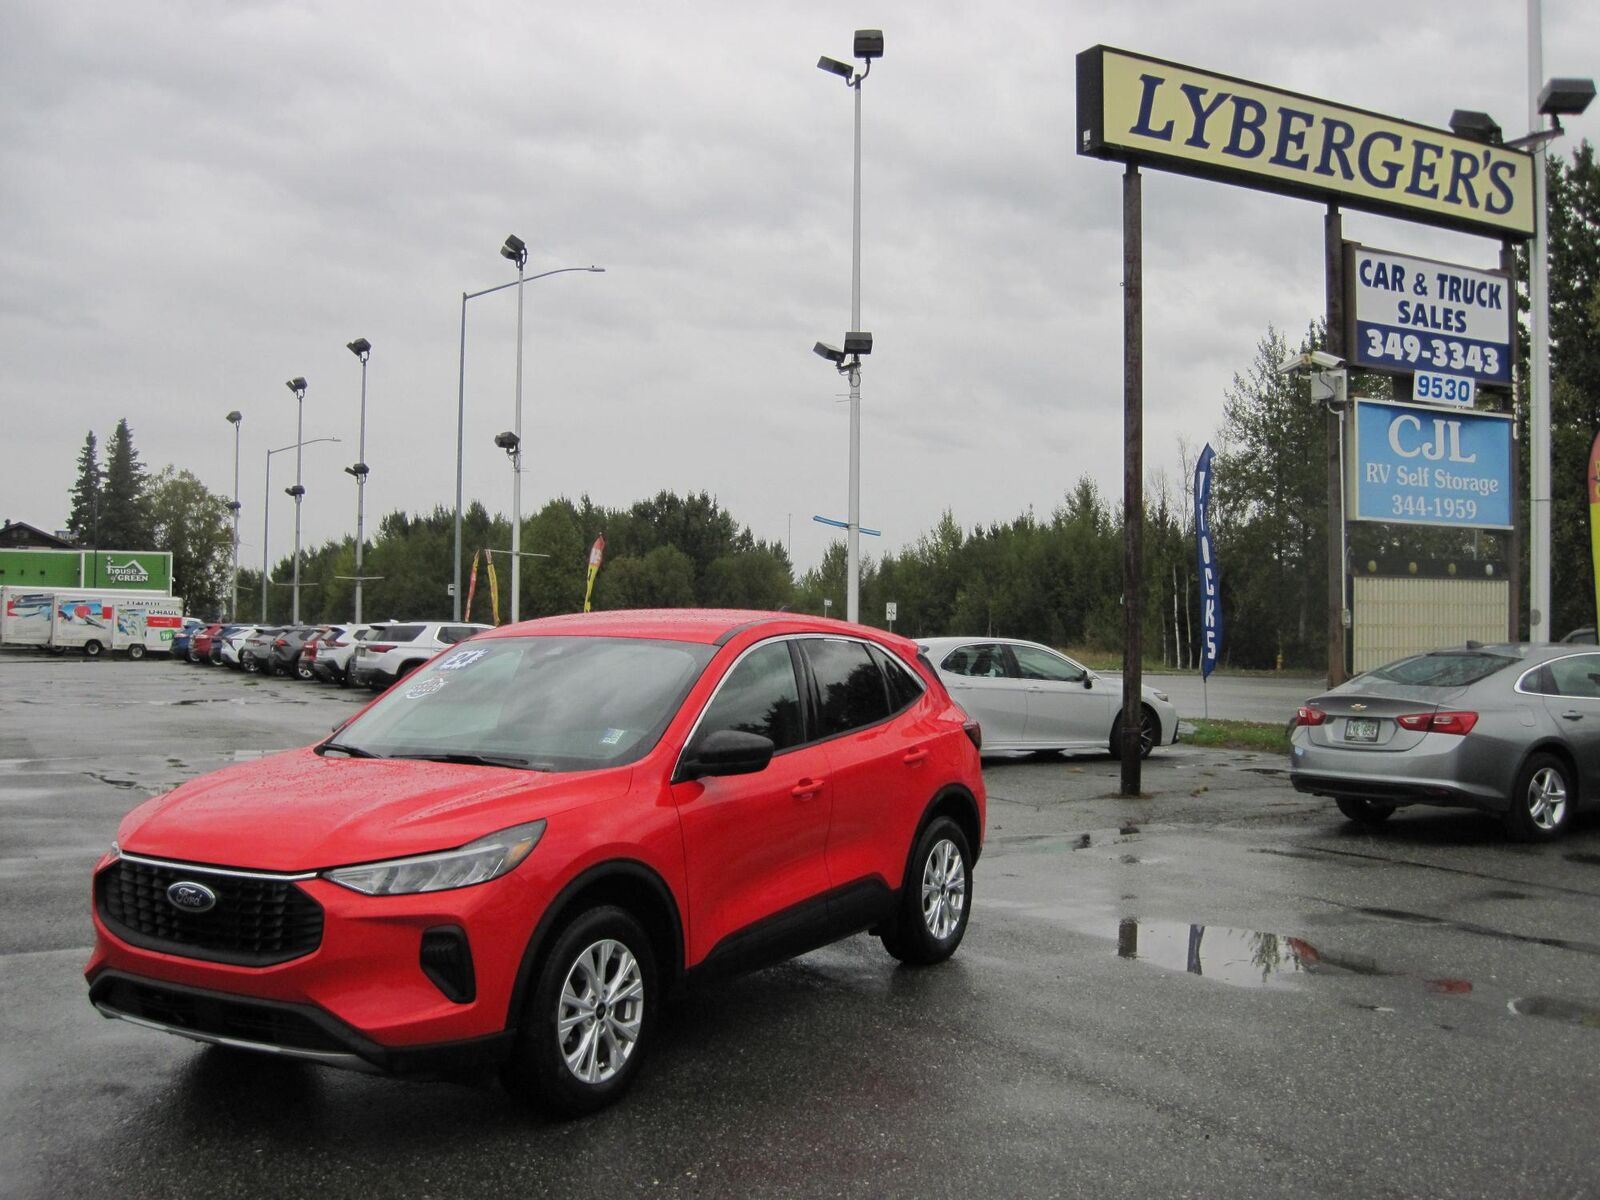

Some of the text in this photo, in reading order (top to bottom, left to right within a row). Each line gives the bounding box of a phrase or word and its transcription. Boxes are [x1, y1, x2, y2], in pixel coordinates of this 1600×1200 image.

[1129, 73, 1517, 215] LYBERGER'S
[1359, 259, 1502, 310] CAR & TRUCK
[1397, 300, 1467, 333] SALES
[1366, 329, 1499, 374] 349-3343
[1417, 375, 1470, 402] 9530
[1388, 414, 1477, 463] CJL
[1366, 462, 1499, 496] RV Self Storage
[1391, 494, 1477, 520] 344-1959
[117, 574, 149, 582] GREEN
[1199, 471, 1216, 660] CKS
[176, 887, 203, 906] Ford
